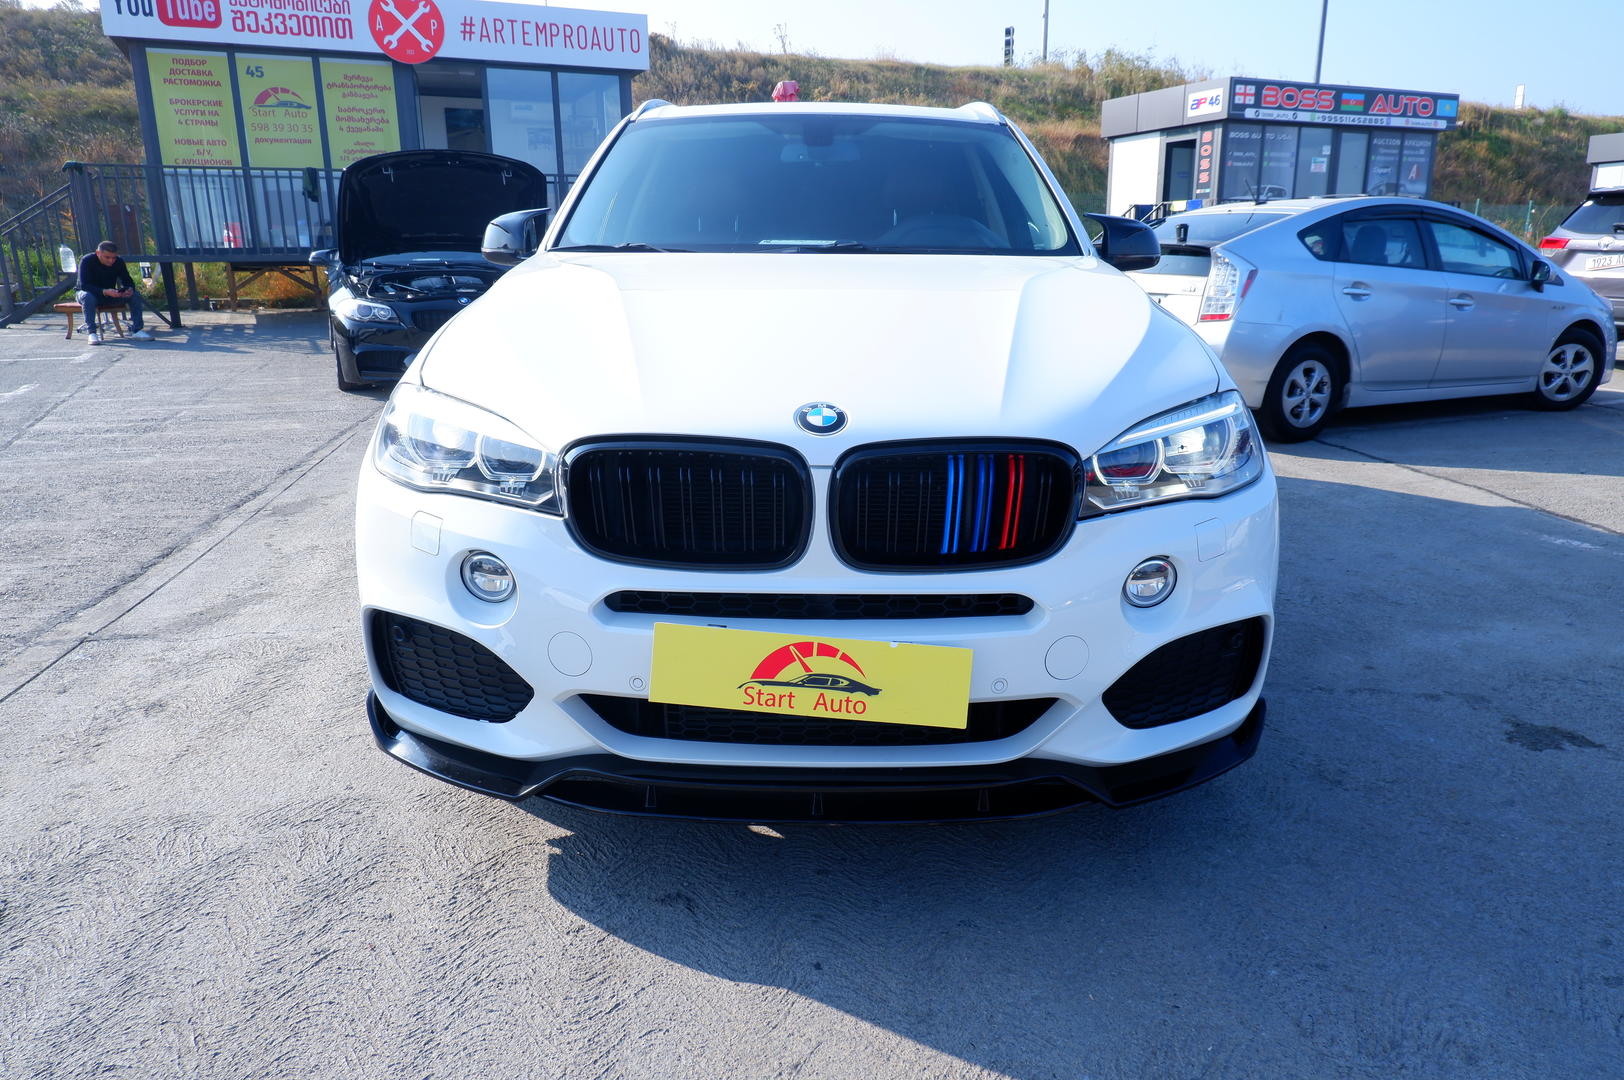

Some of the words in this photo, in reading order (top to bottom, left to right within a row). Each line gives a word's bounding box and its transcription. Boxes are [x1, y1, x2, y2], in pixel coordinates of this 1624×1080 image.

[376, 14, 384, 31] A
[430, 19, 438, 36] P
[460, 15, 641, 54] #ARTEMPROAUTO
[171, 57, 208, 67] ПОДБОР
[169, 67, 213, 77] ДОСТАВКА
[246, 66, 264, 78] 45
[163, 78, 222, 88] РАСТОМОЖКА
[169, 98, 223, 107] БРОКЕРСКИЕ
[1208, 94, 1221, 107] 46
[1262, 85, 1336, 111] BOSS
[1368, 94, 1434, 117] AUTO
[174, 108, 206, 117] УСЛУГИ
[251, 108, 276, 118] Start
[284, 109, 309, 119] Auto
[185, 119, 219, 127] СТРАНЫ
[251, 123, 270, 132] 598
[273, 123, 284, 132] 39
[287, 124, 299, 133] 30
[301, 124, 313, 133] 35
[174, 138, 204, 146] НОВЫЕ
[206, 139, 227, 147] АВТО
[255, 137, 312, 145] документация
[1592, 256, 1613, 268] 1923
[743, 686, 796, 709] Start
[813, 692, 867, 715] Auto
